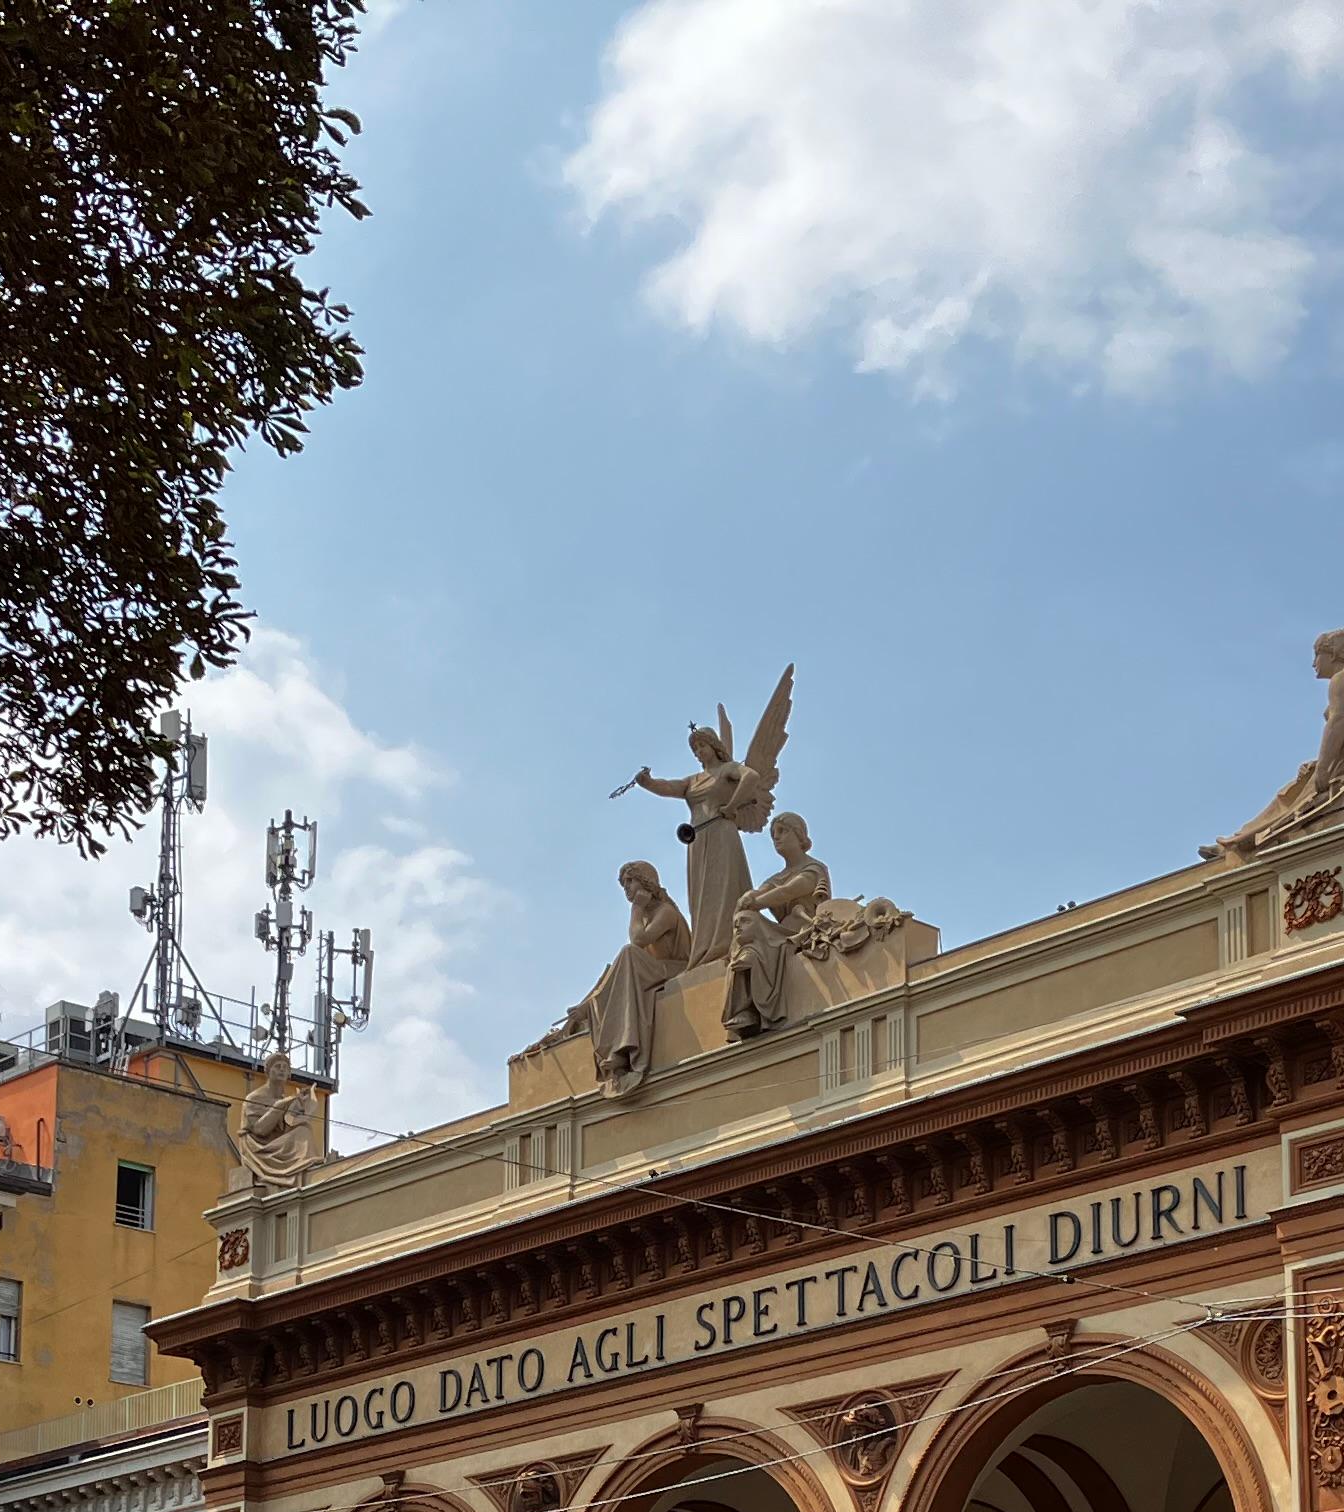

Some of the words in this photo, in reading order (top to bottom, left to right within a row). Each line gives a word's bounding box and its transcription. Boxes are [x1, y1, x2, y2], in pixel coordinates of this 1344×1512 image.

[287, 1381, 416, 1450] LUOGO
[438, 1347, 545, 1413] DATO
[567, 1314, 665, 1382] AGLI
[694, 1223, 1016, 1351] SPETTACOLI
[1048, 1165, 1248, 1264] DIURNI
